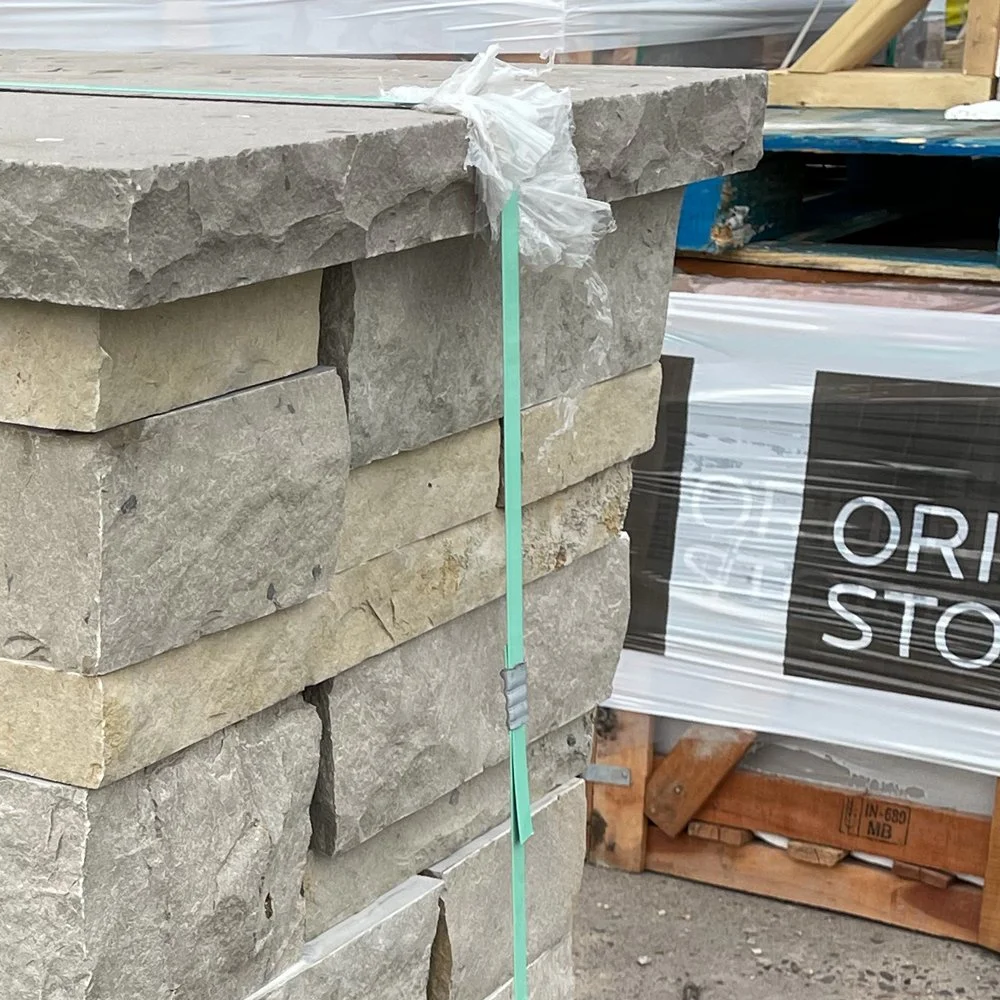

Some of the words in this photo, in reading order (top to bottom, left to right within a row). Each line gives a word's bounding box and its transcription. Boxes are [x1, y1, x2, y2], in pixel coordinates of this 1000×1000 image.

[833, 495, 999, 583] ORI
[821, 583, 1000, 669] STO
[867, 821, 892, 839] MB
